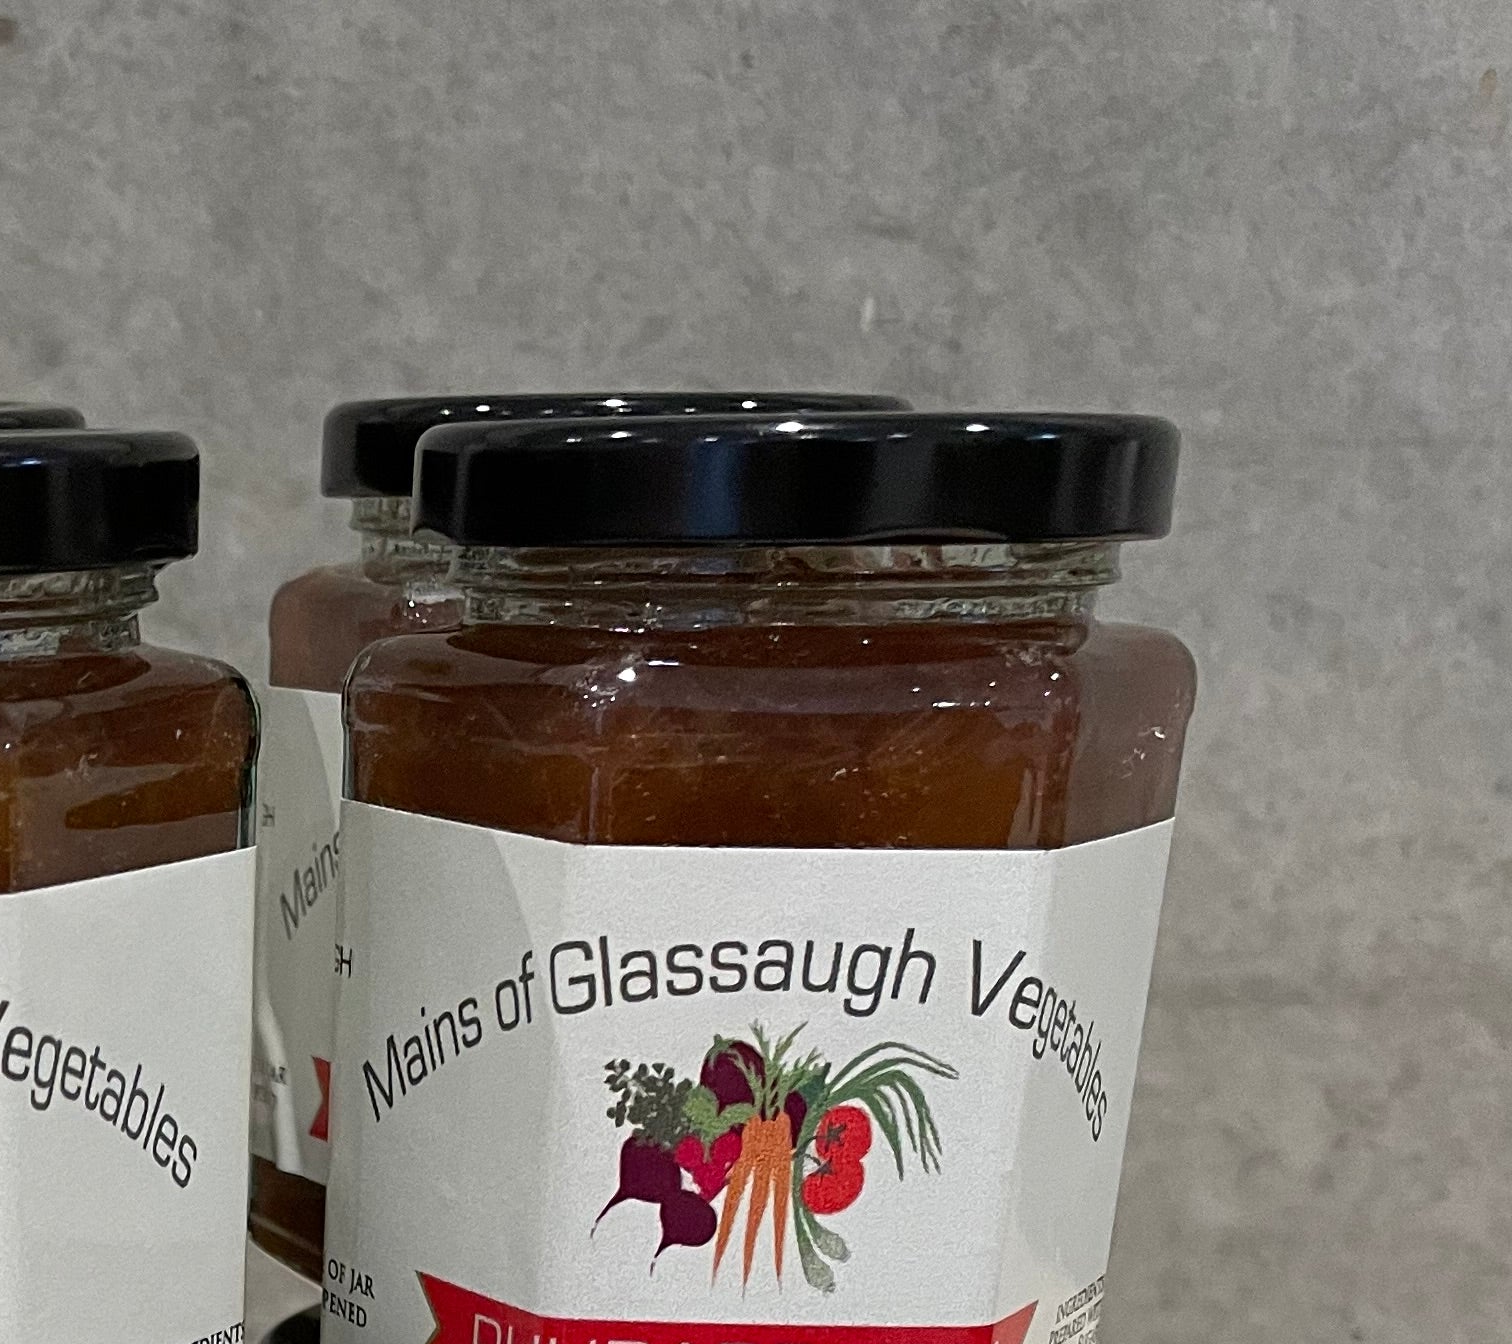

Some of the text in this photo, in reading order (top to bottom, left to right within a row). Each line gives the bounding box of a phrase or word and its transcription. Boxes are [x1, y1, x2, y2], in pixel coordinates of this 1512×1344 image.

[362, 928, 1109, 1142] Mains of Glassaugh Vegetables
[328, 1258, 376, 1301] OF JAR
[322, 1287, 367, 1328] PENED
